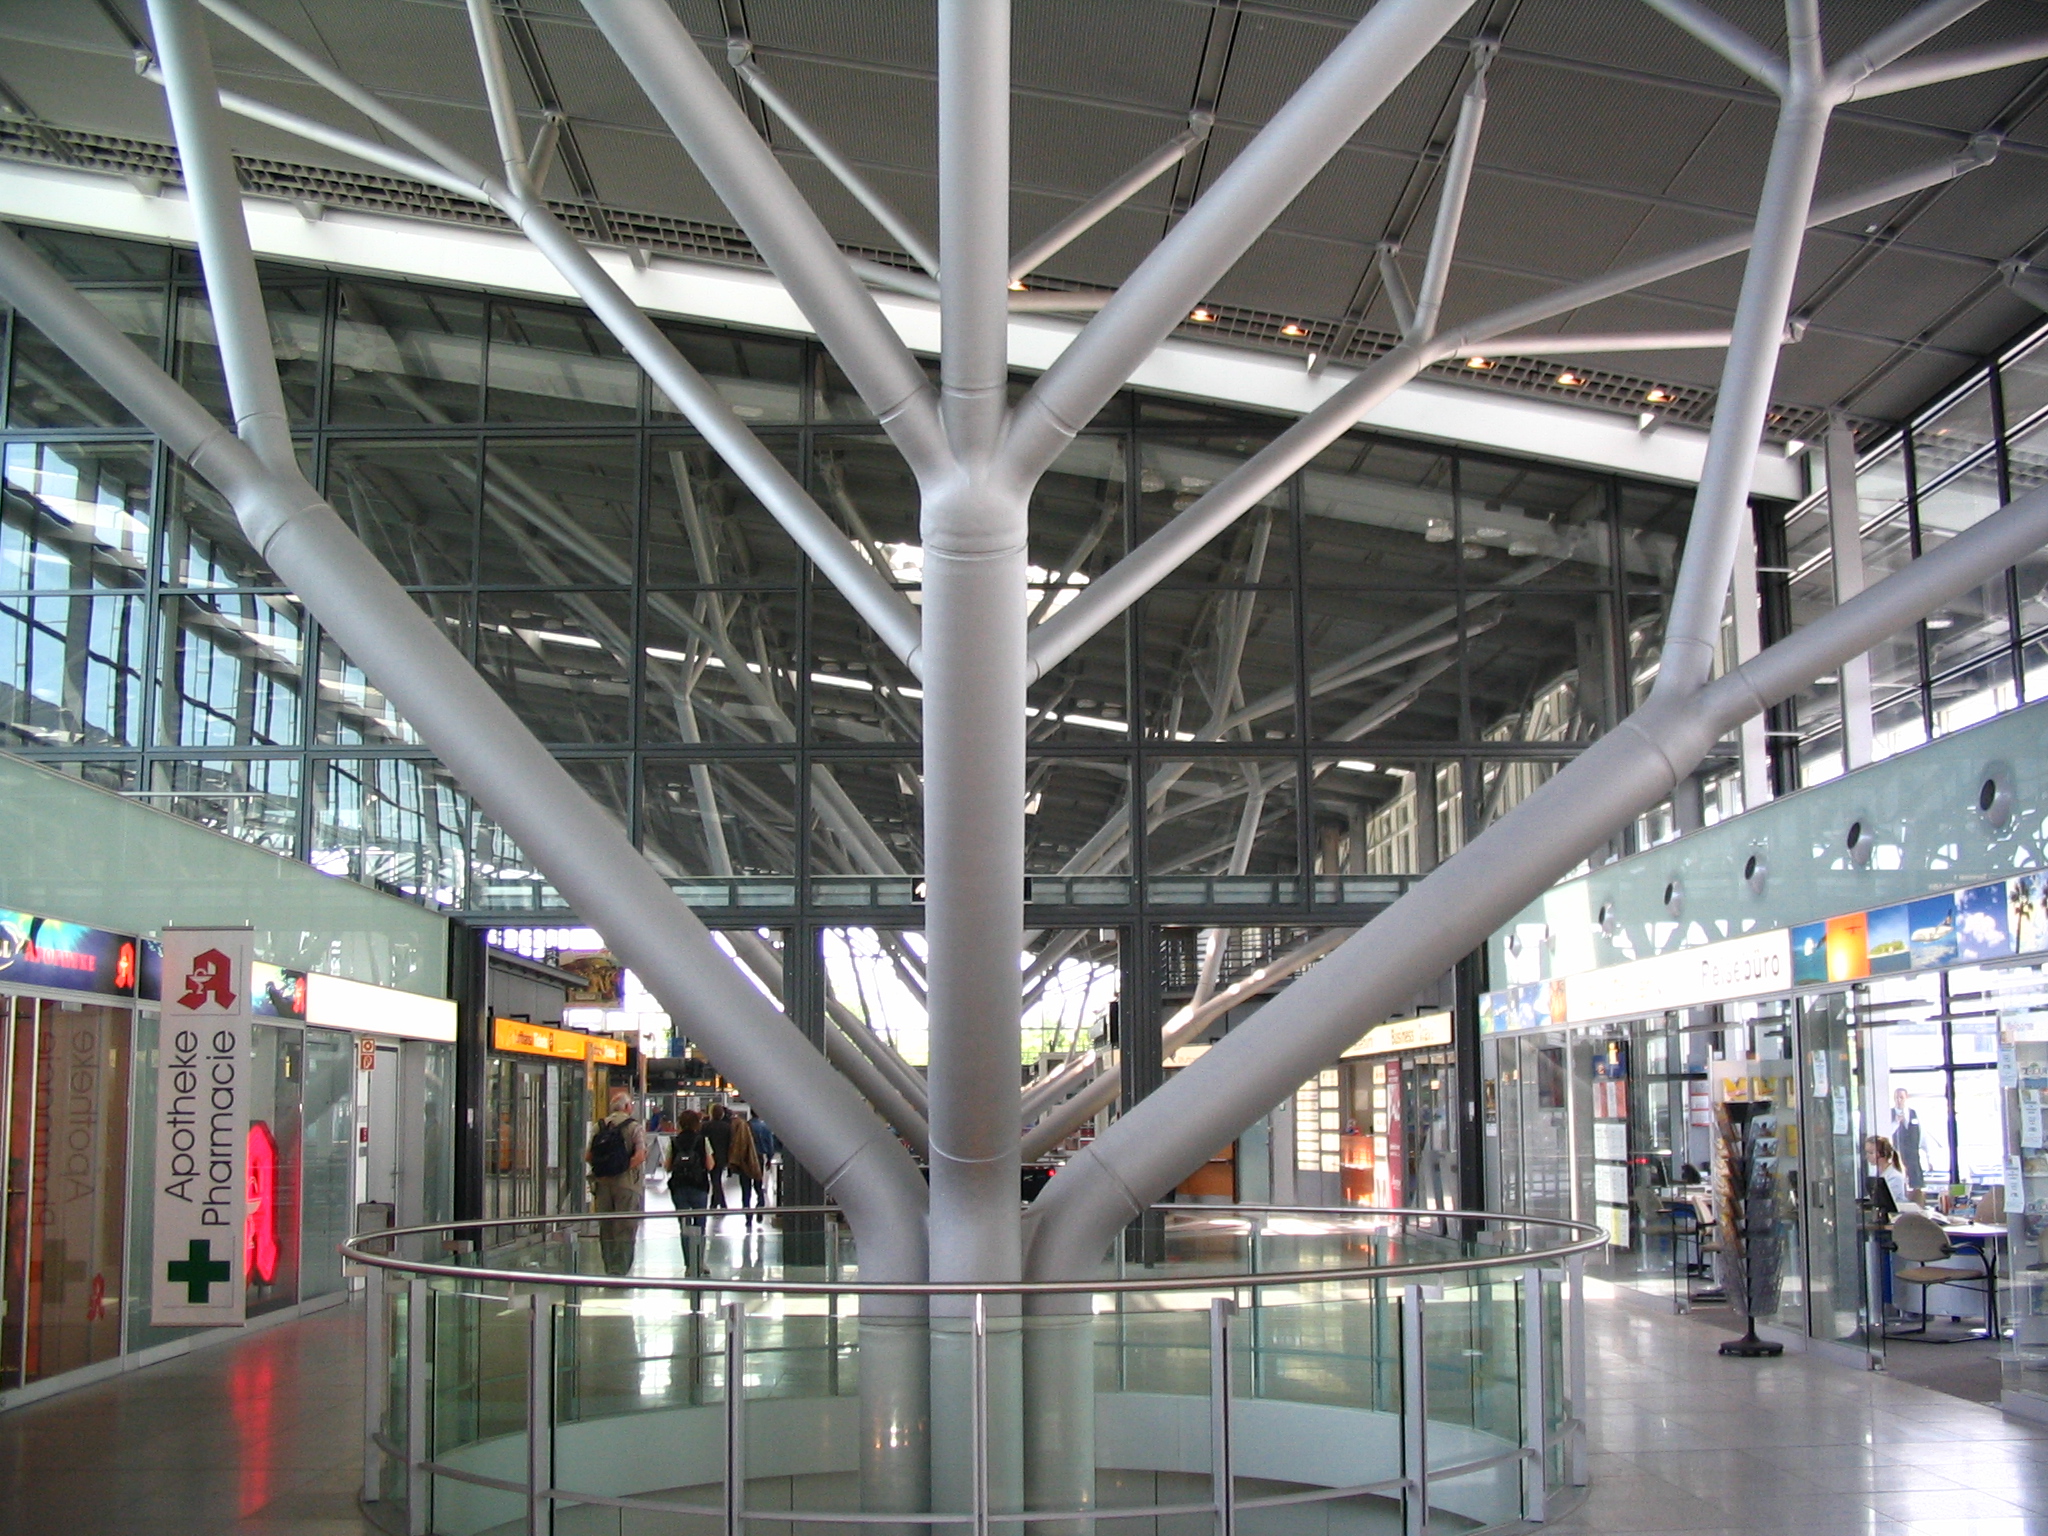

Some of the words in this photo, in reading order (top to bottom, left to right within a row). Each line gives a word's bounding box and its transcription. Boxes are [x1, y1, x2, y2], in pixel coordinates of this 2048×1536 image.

[1701, 948, 1780, 988] Reisebüro
[164, 1030, 201, 1203] Apotheke
[201, 1030, 236, 1226] Pharmacie
